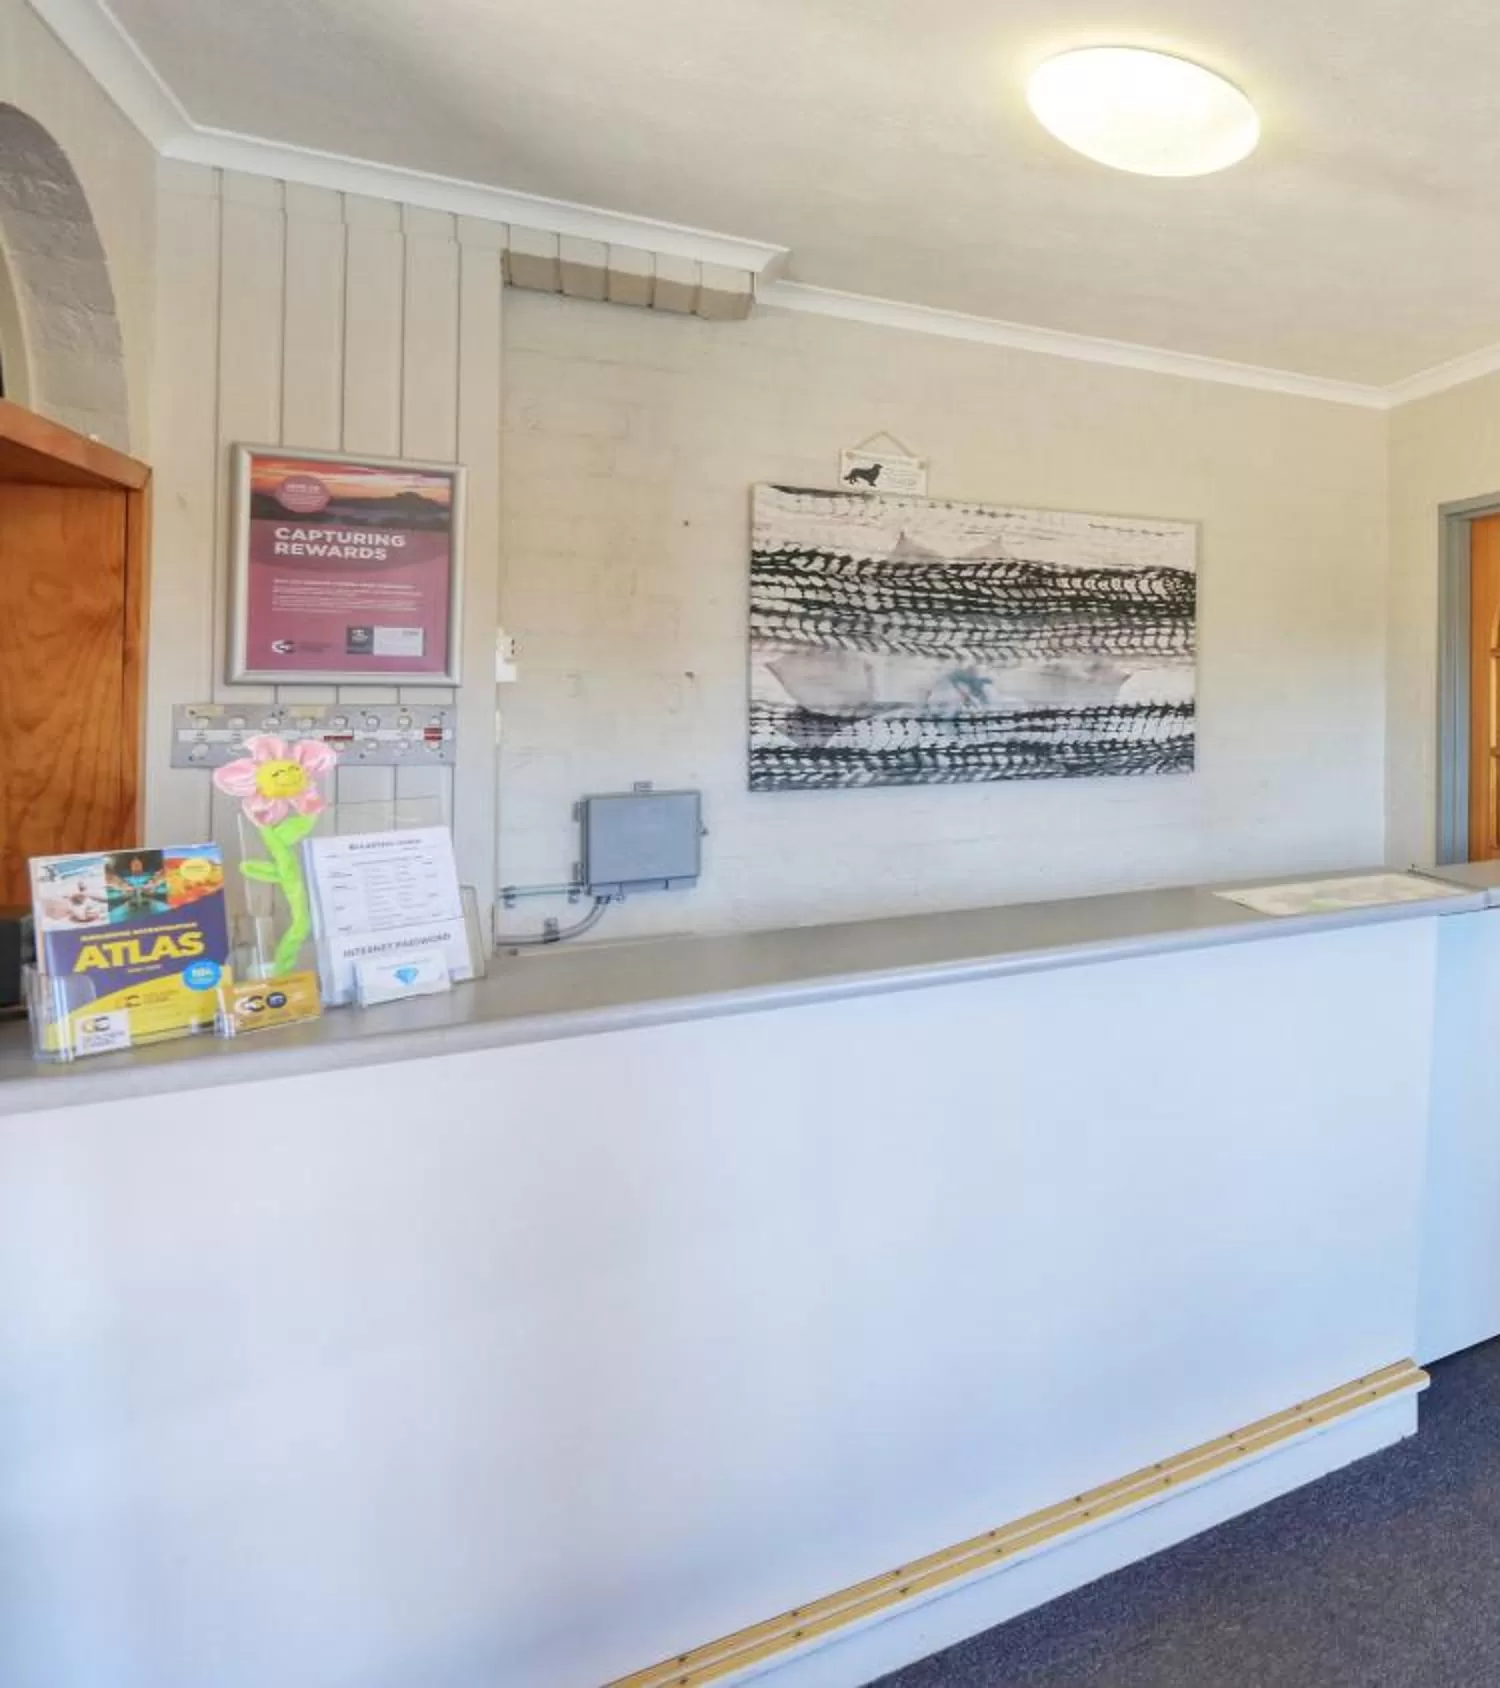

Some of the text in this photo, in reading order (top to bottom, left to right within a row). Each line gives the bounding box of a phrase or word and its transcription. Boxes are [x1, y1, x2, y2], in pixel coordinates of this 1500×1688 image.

[274, 527, 407, 547] CAPTURING
[274, 541, 388, 561] REWARDS
[74, 930, 206, 973] ATLAS
